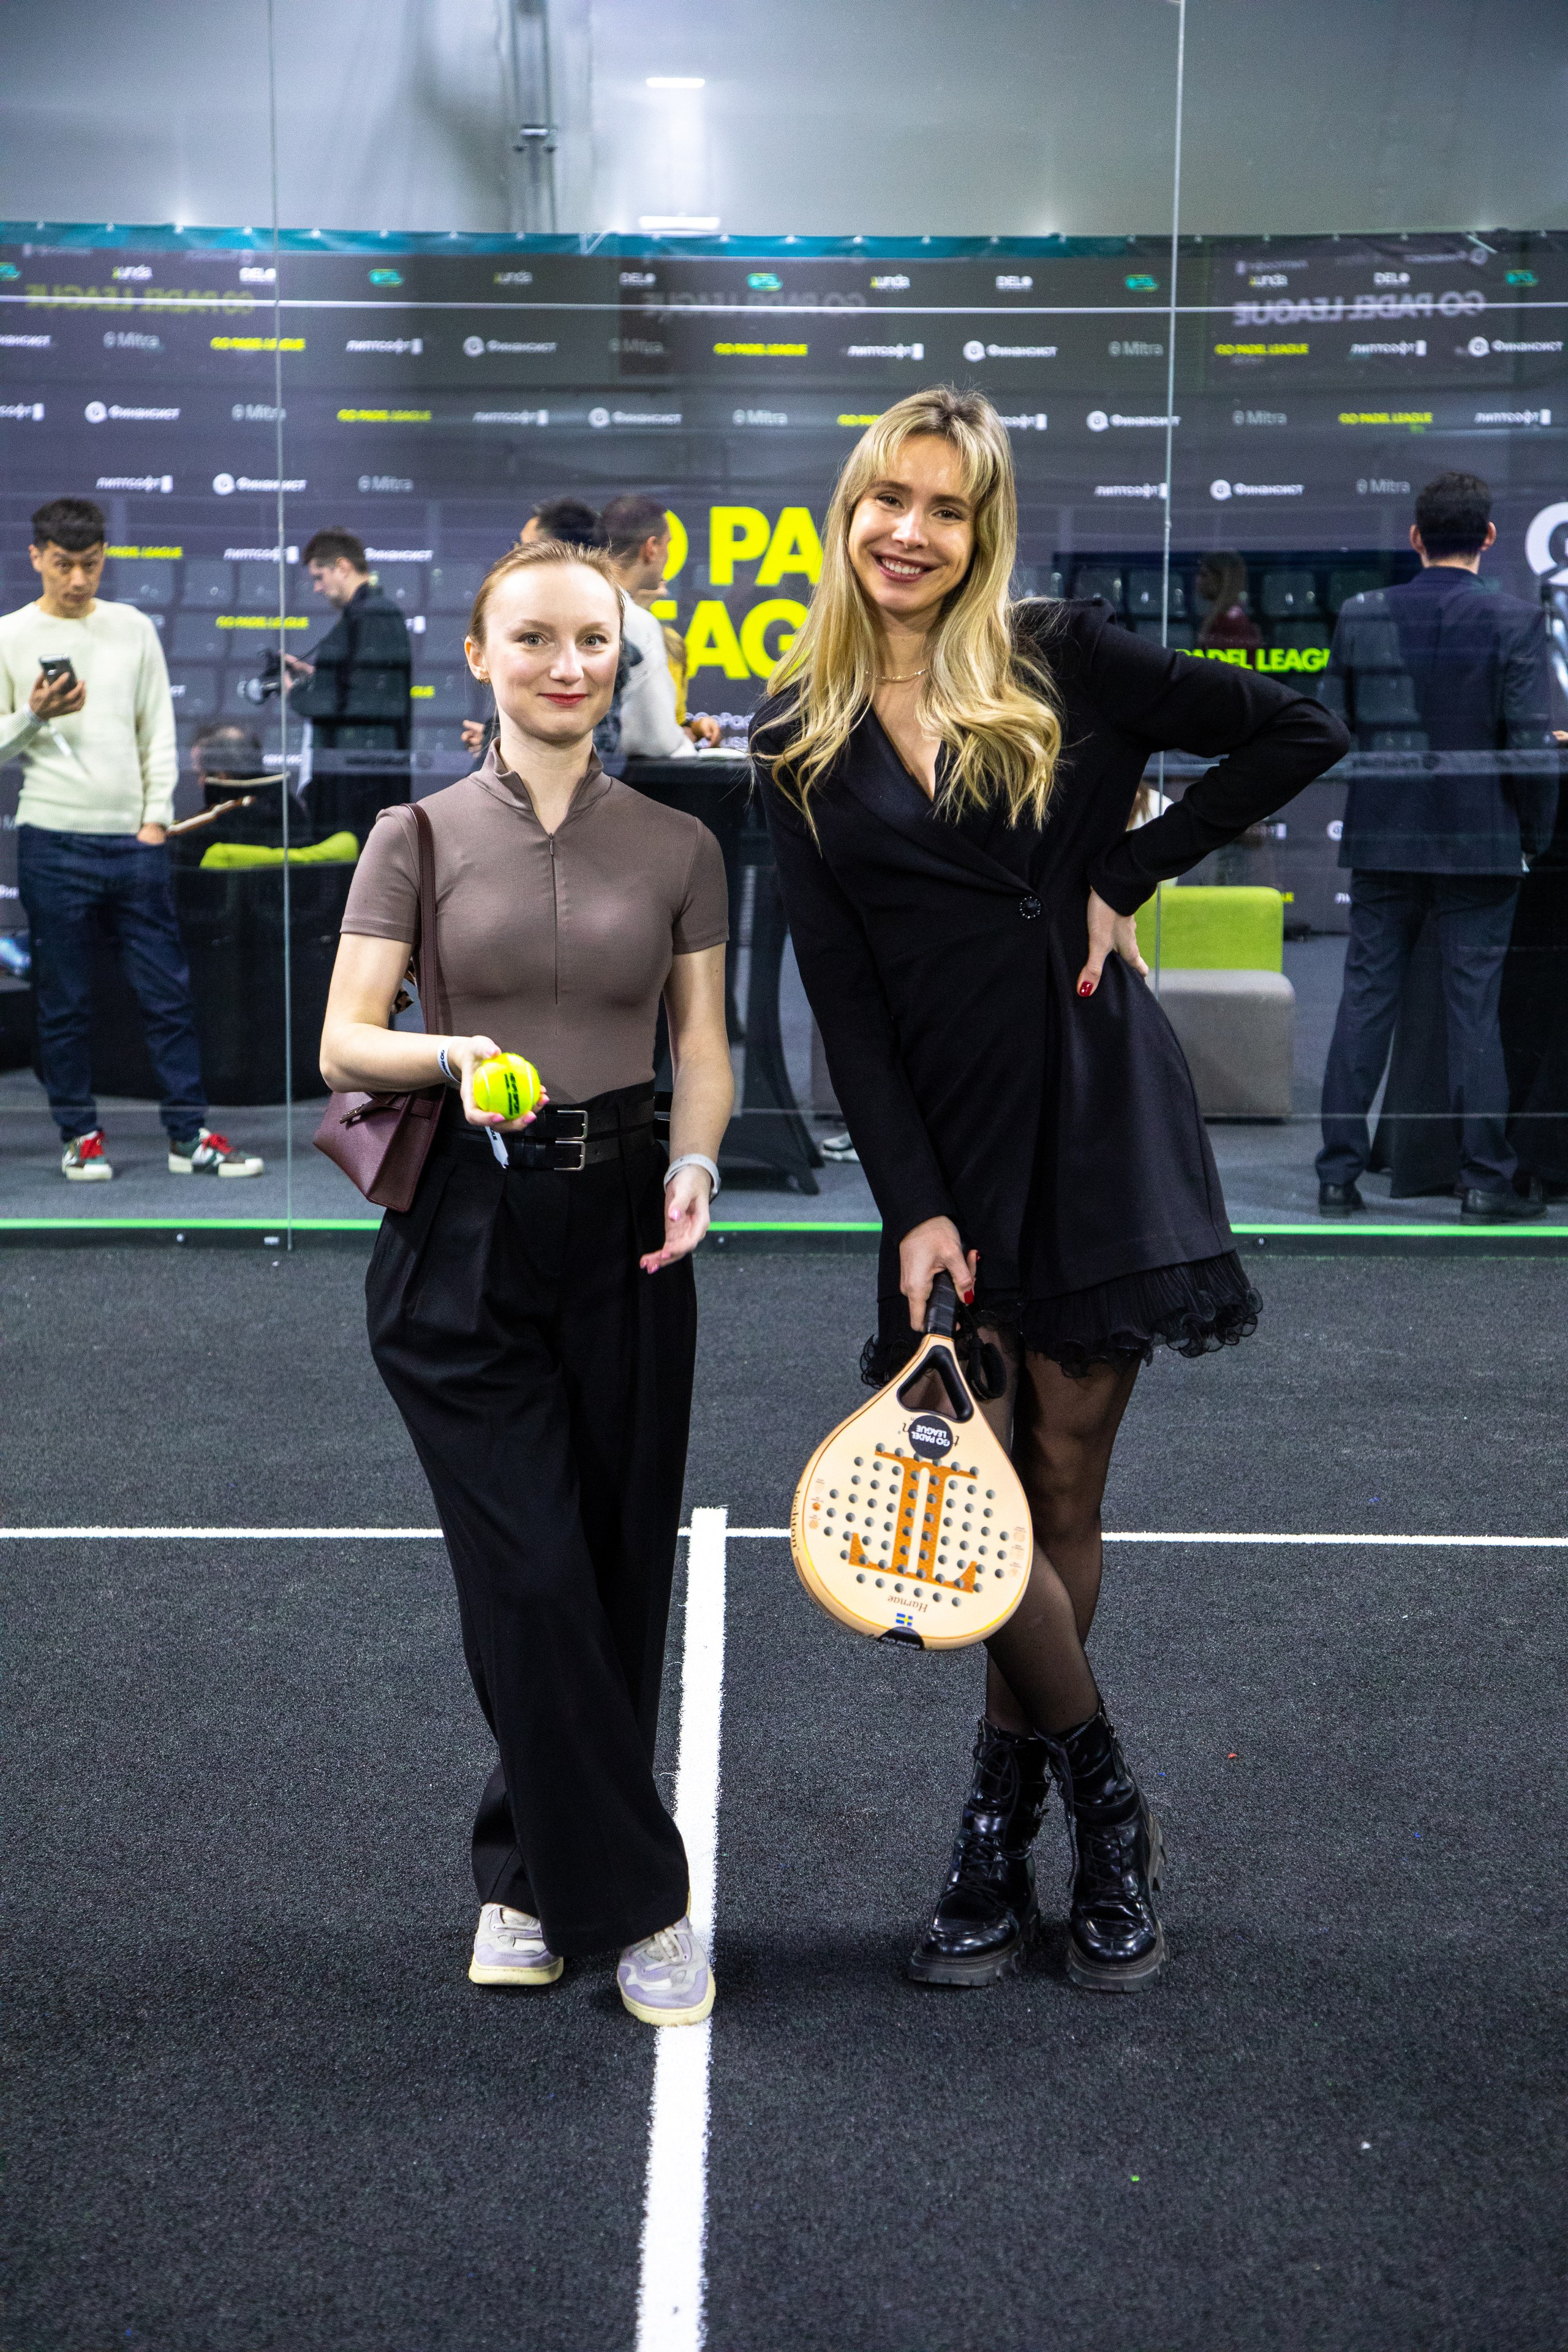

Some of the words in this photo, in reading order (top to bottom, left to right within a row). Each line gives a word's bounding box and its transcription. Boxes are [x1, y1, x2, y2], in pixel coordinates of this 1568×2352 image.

[911, 1431, 935, 1444] PADEL
[916, 1424, 947, 1439] LEAGUE
[936, 1437, 951, 1447] GO
[887, 1595, 929, 1613] Harnae
